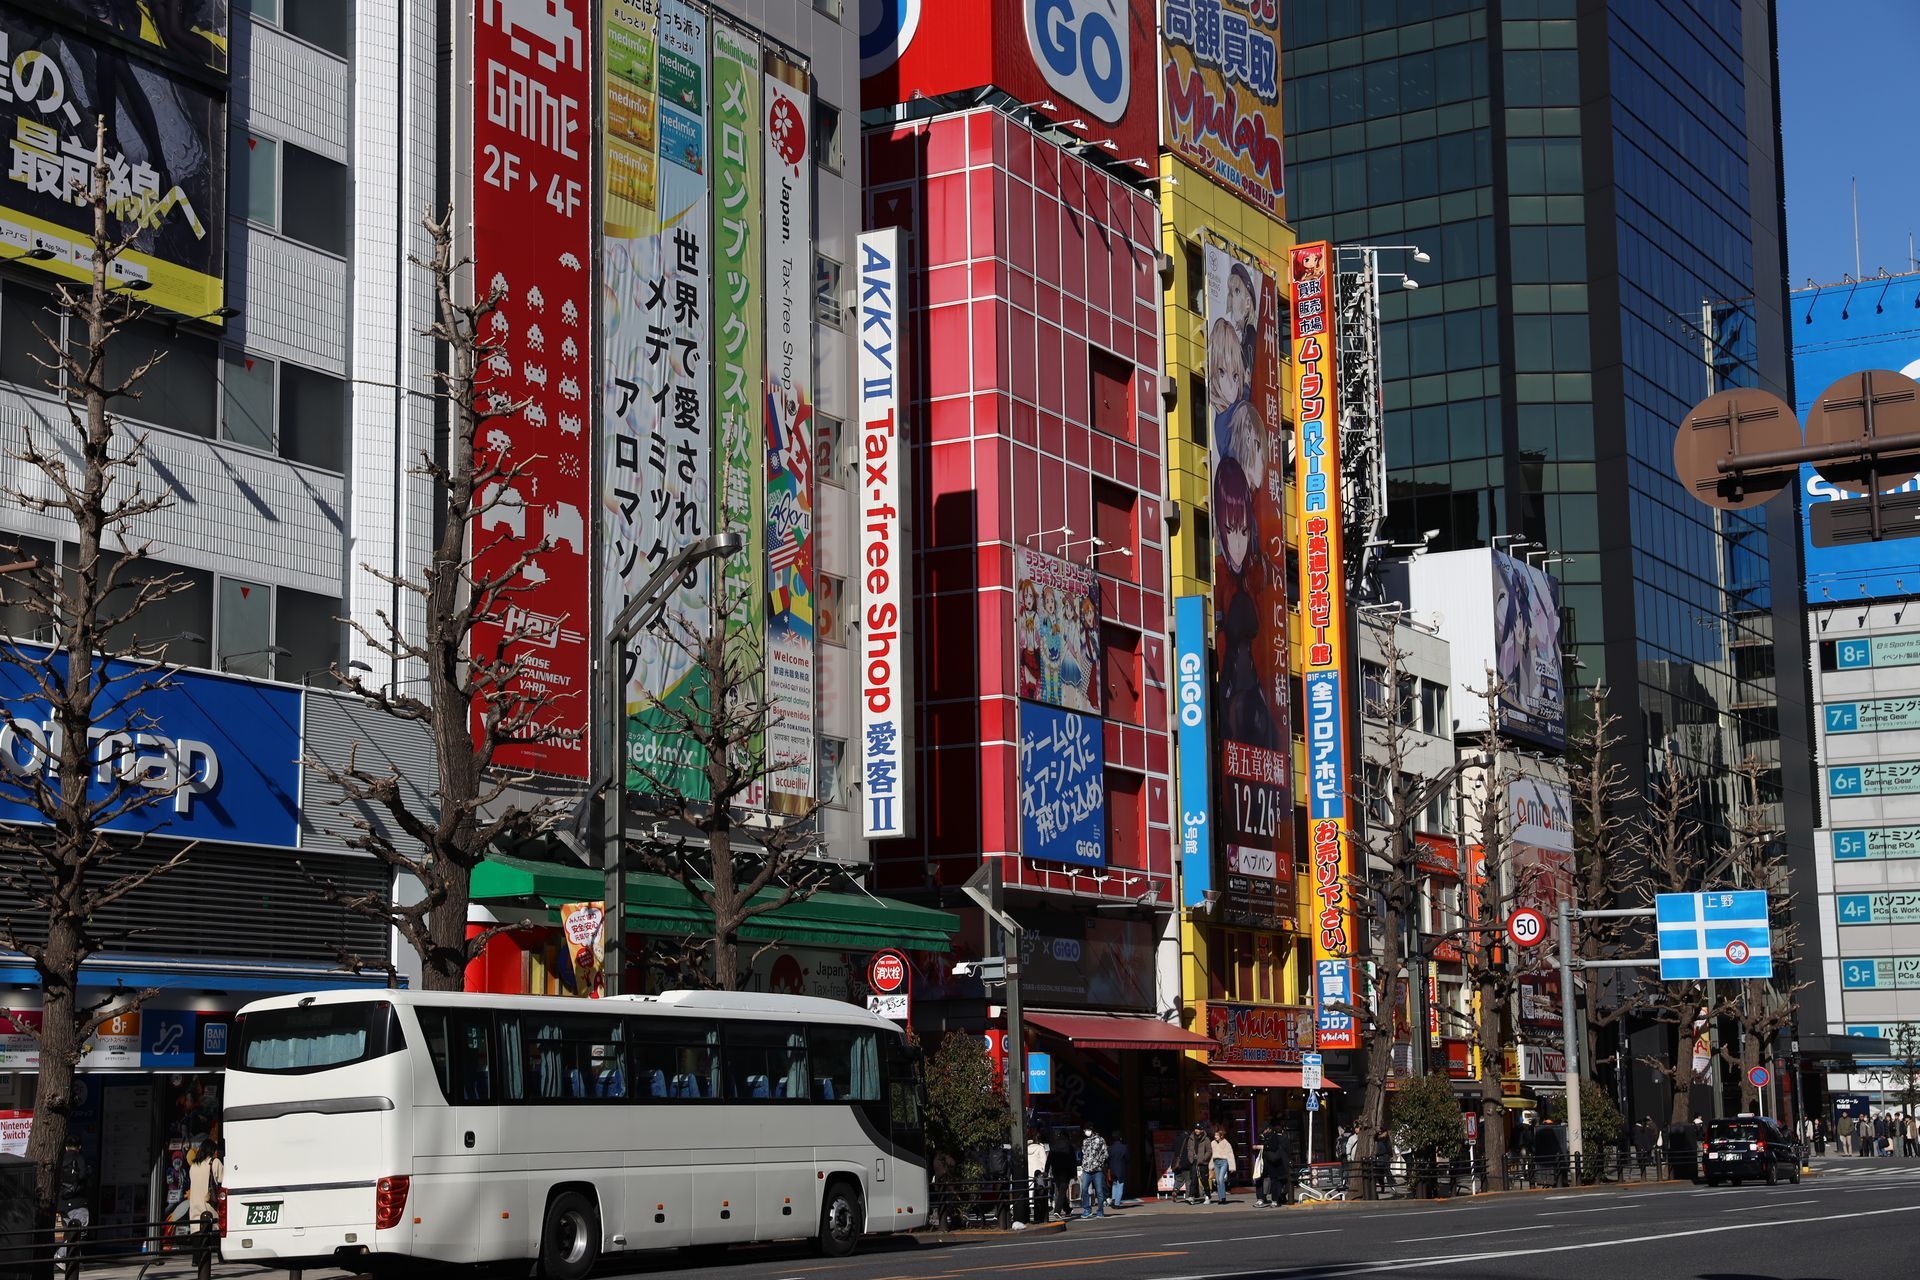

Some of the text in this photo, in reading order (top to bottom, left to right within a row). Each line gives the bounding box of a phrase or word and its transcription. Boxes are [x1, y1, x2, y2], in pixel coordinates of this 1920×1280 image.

[608, 26, 648, 56] medimix
[660, 53, 696, 80] medimix
[487, 57, 579, 161] GAME
[608, 87, 648, 116] medimix
[1164, 57, 1284, 198] Mulan
[609, 147, 649, 175] medimix
[483, 143, 582, 219] 2F 4F
[781, 177, 793, 246] Japan.
[5, 229, 28, 243] PS5
[45, 242, 68, 255] App Store
[124, 268, 144, 280] Windows
[1298, 280, 1321, 299] 買取
[862, 242, 892, 370] AKKY
[1299, 299, 1322, 315] 販売
[781, 257, 793, 391] Tax-free Shop
[1300, 316, 1323, 334] 市場
[864, 407, 898, 714] Tax-free Shop
[503, 607, 561, 649] Hey
[514, 653, 551, 671] HROSE
[773, 650, 810, 668] Welcome
[1844, 646, 1865, 662] 8F
[519, 679, 546, 693] YARD
[1180, 652, 1203, 727] GiGO
[772, 706, 810, 722] Bienvenidos
[1830, 710, 1852, 727] 7F
[1860, 713, 1908, 723] Gaming Gear
[626, 731, 646, 742] ミックス
[1021, 713, 1082, 772] ゲームの
[1312, 681, 1336, 818] 全フロアホビー
[1226, 742, 1284, 785] 第五章後編
[775, 776, 807, 791] accueillir
[1022, 733, 1096, 818] オアシスに
[1834, 773, 1857, 789] 6F
[1864, 777, 1913, 787] Gaming Gear
[745, 783, 763, 806] 1F
[1234, 783, 1275, 838] 12.26
[1076, 839, 1101, 859] GiGO
[1839, 836, 1861, 854] 5F
[1868, 841, 1915, 851] Gaming PCs
[1704, 894, 1734, 909] 上野
[1844, 900, 1866, 917] 4F
[1901, 906, 1920, 914] Work
[1516, 918, 1537, 936] 50
[876, 966, 901, 980] 消火栓
[1319, 961, 1346, 976] 2F
[1848, 965, 1871, 982] 3F
[111, 1015, 128, 1034] 8F
[1235, 1009, 1287, 1046] Mulan
[1321, 1017, 1349, 1030] フロア
[207, 1028, 225, 1038] BAN
[1321, 1031, 1350, 1043] Mulan
[207, 1039, 221, 1049] DAI
[1030, 1069, 1046, 1077] GiGO
[2, 1131, 26, 1140] Switch
